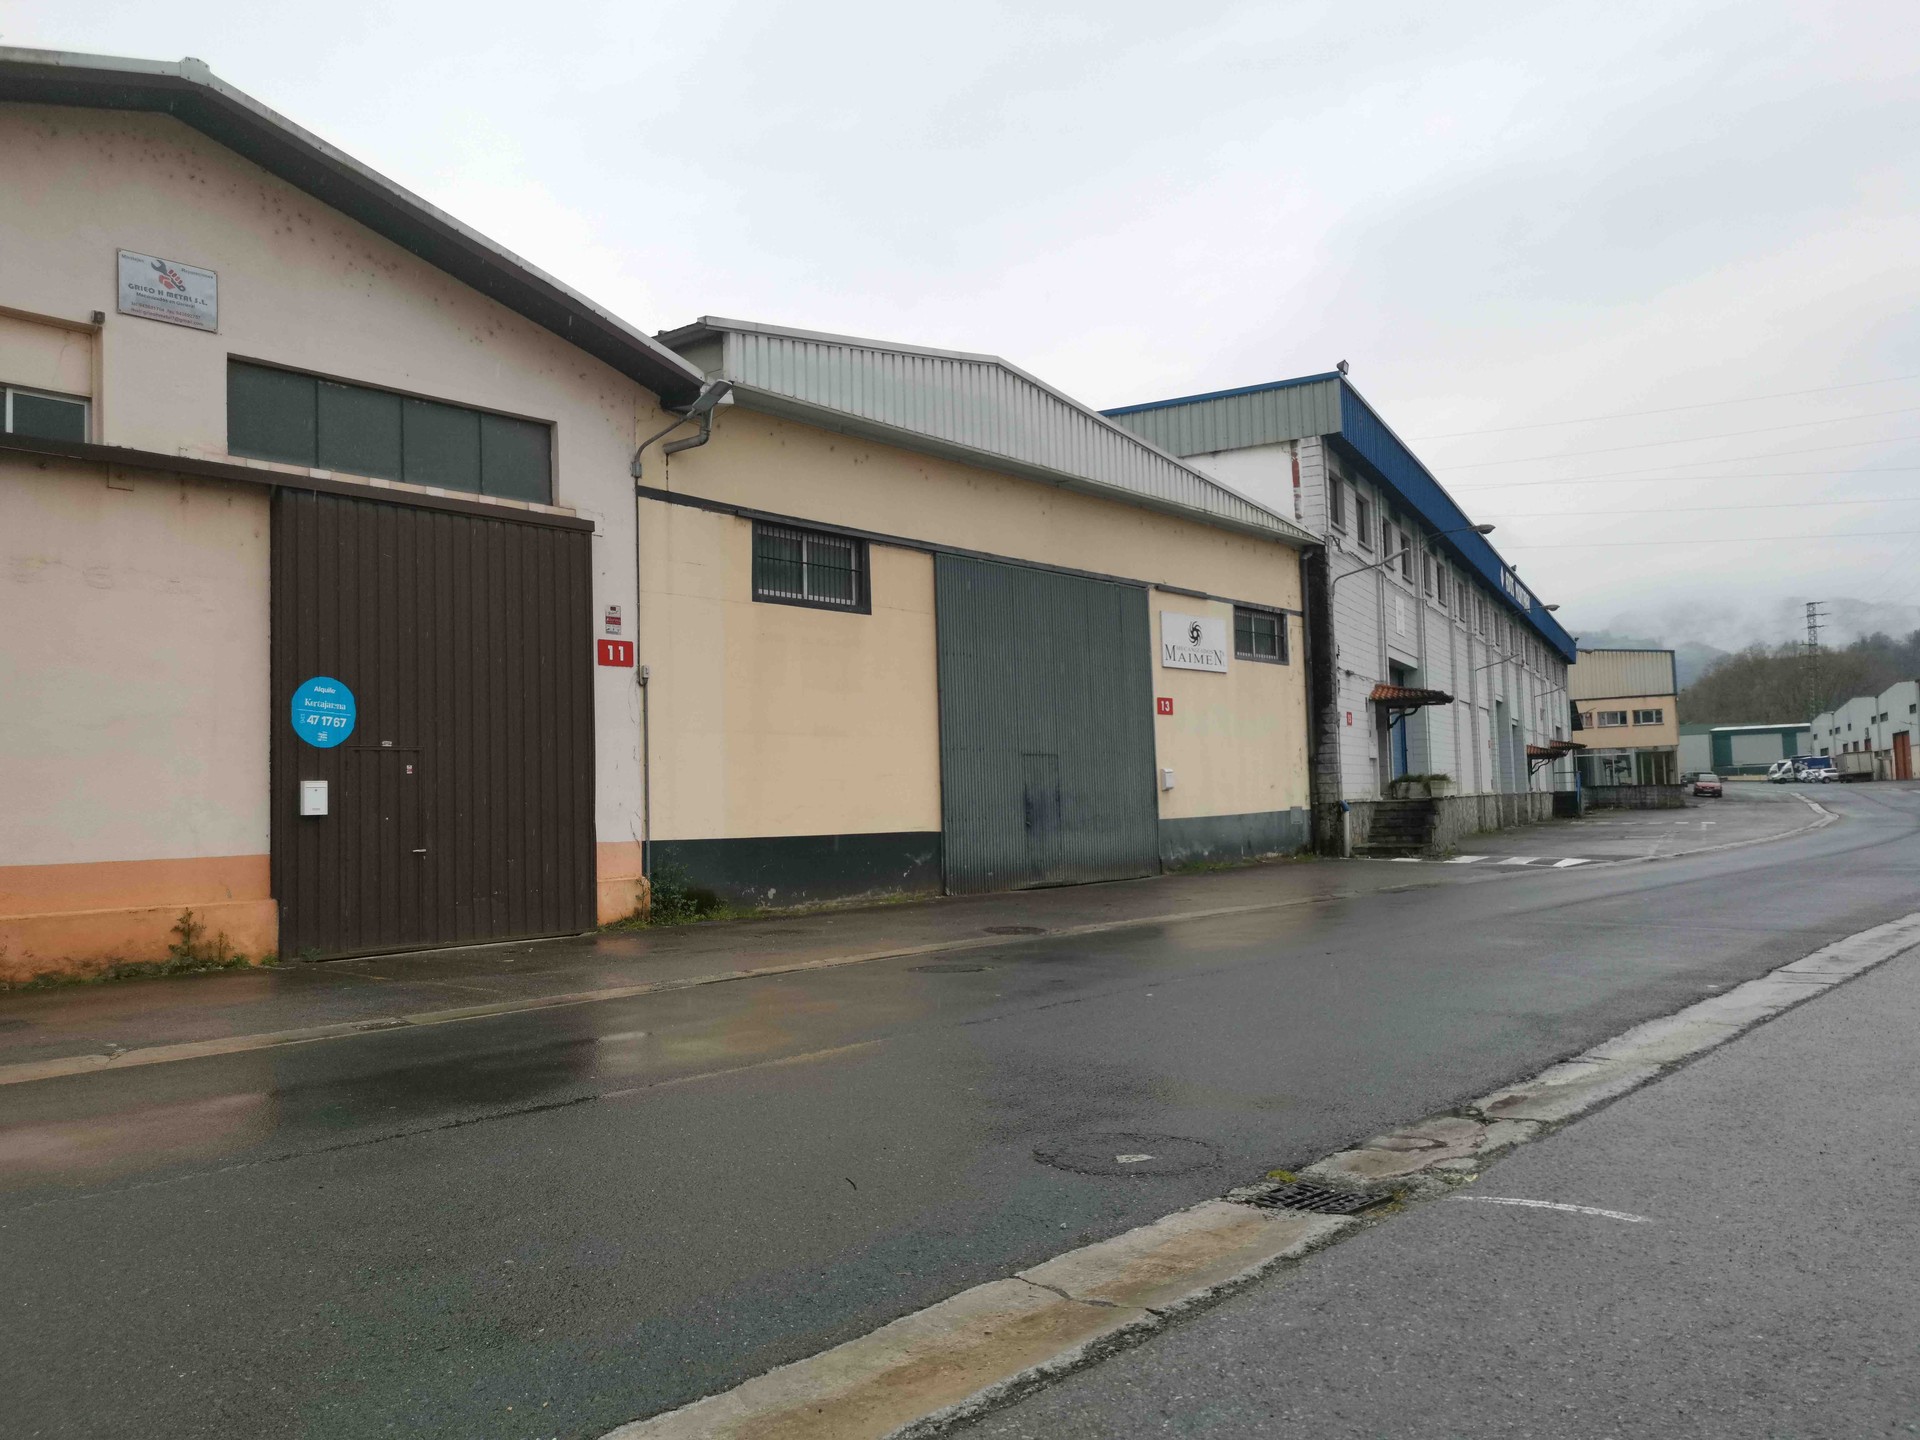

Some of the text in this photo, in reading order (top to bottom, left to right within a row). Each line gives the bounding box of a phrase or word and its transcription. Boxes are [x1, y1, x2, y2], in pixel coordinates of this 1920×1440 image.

[166, 291, 193, 302] METAL
[195, 297, 208, 306] S.L.
[608, 645, 624, 661] 11
[1164, 643, 1223, 666] MAIMEN
[1161, 701, 1170, 711] 13
